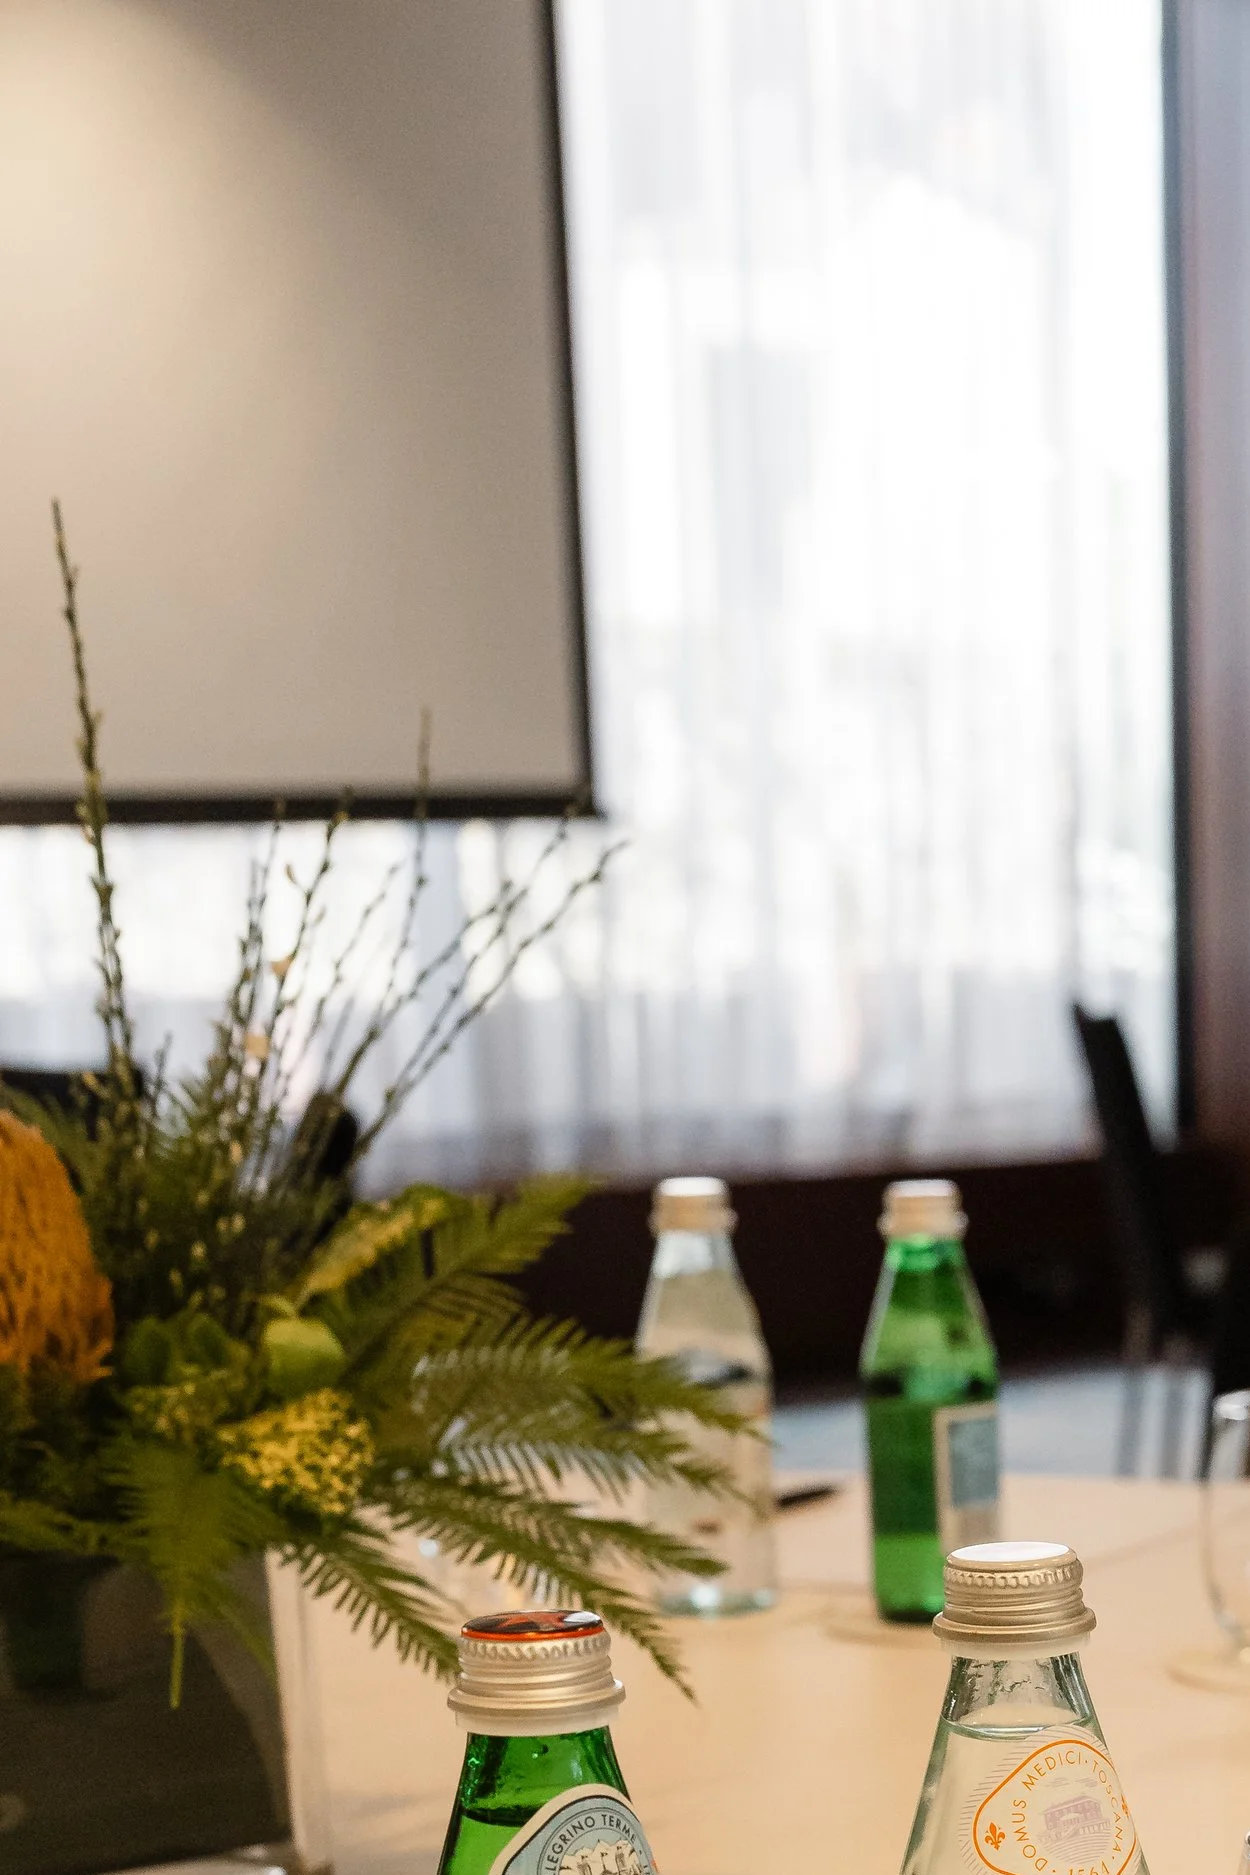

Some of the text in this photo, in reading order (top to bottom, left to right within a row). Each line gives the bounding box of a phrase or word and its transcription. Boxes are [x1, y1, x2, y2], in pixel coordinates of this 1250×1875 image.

[601, 1814, 637, 1844] TERME
[1011, 1799, 1048, 1872] DOMUS
[1092, 1760, 1123, 1853] TOSCANA
